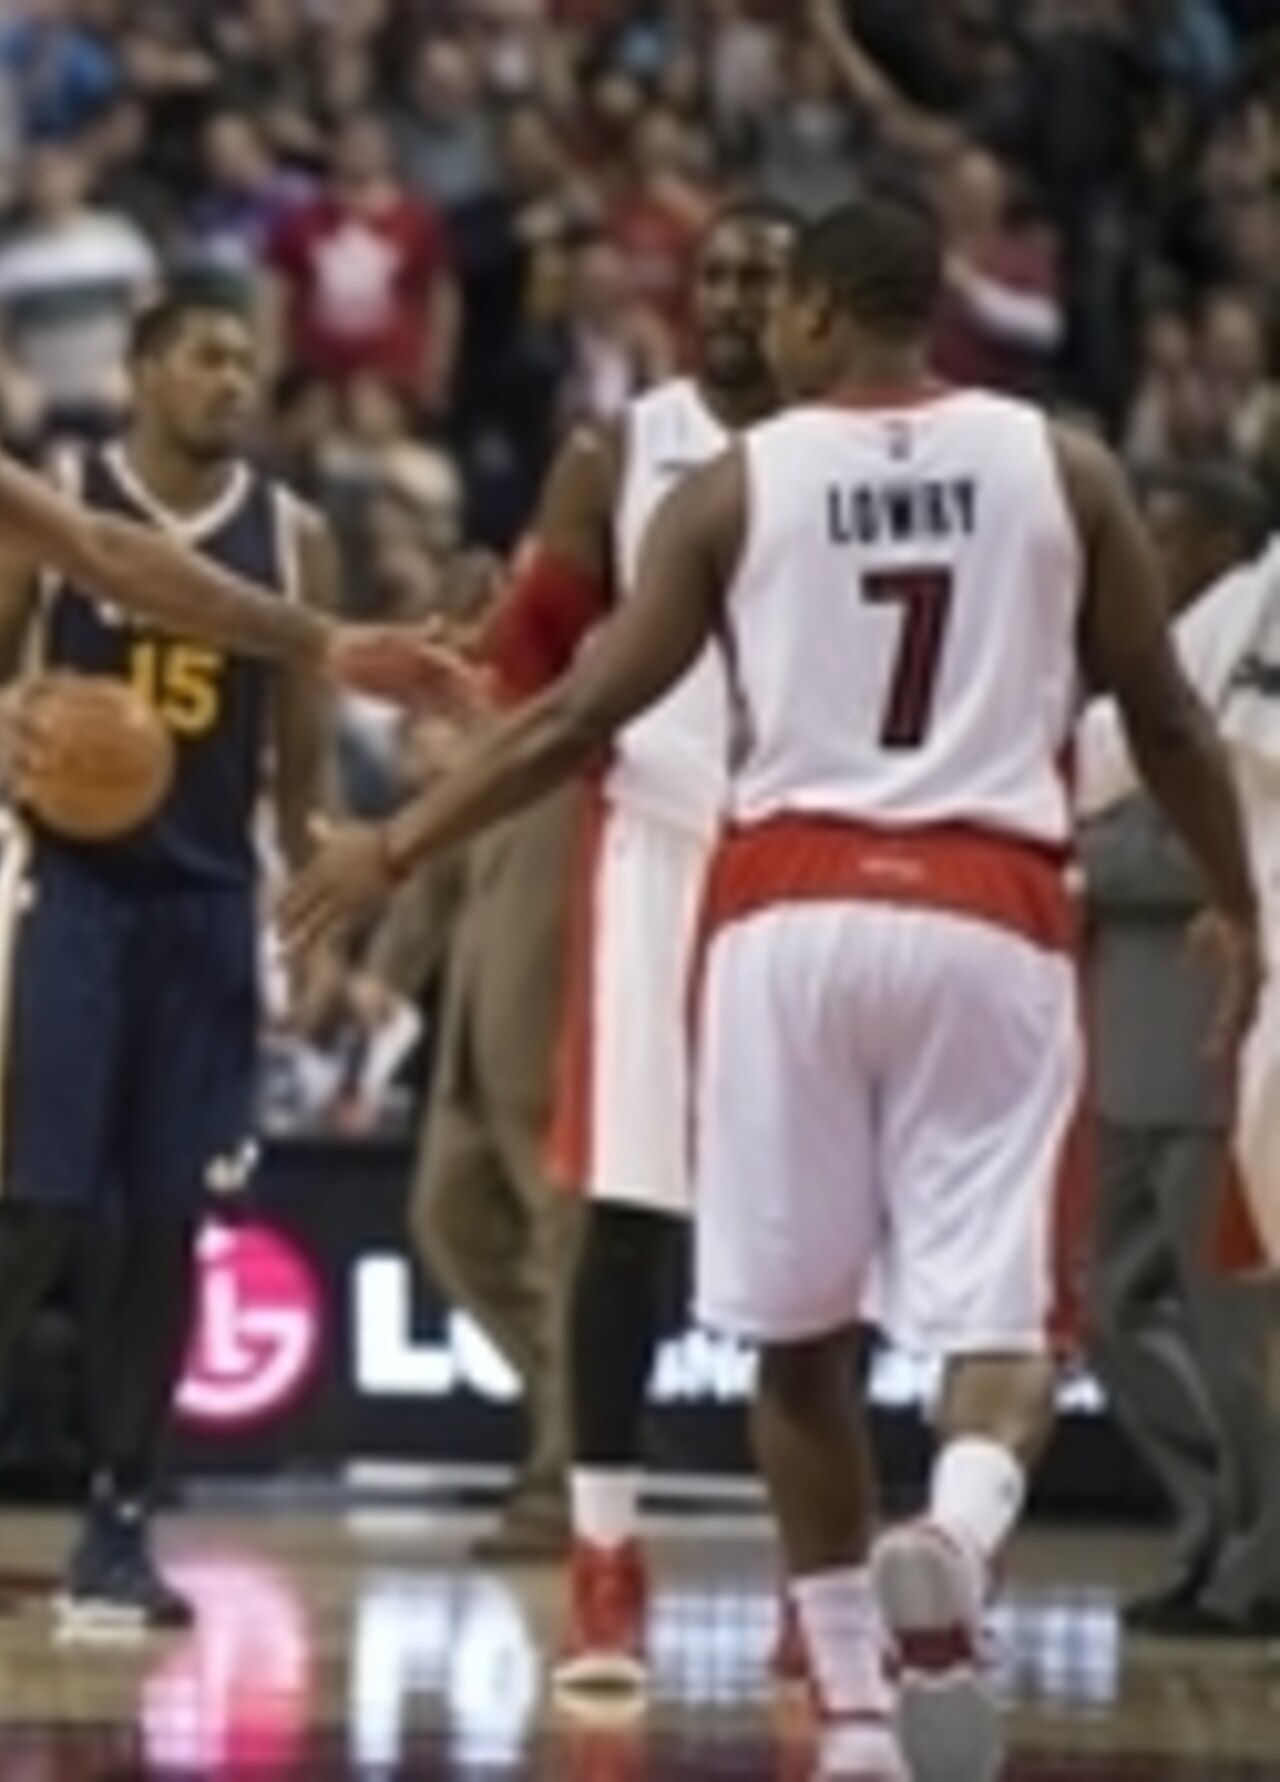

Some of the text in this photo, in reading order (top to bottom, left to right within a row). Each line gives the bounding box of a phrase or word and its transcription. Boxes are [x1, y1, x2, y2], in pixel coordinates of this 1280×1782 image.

[828, 478, 975, 544] LOWRY
[130, 640, 221, 735] 15
[860, 564, 956, 752] 7
